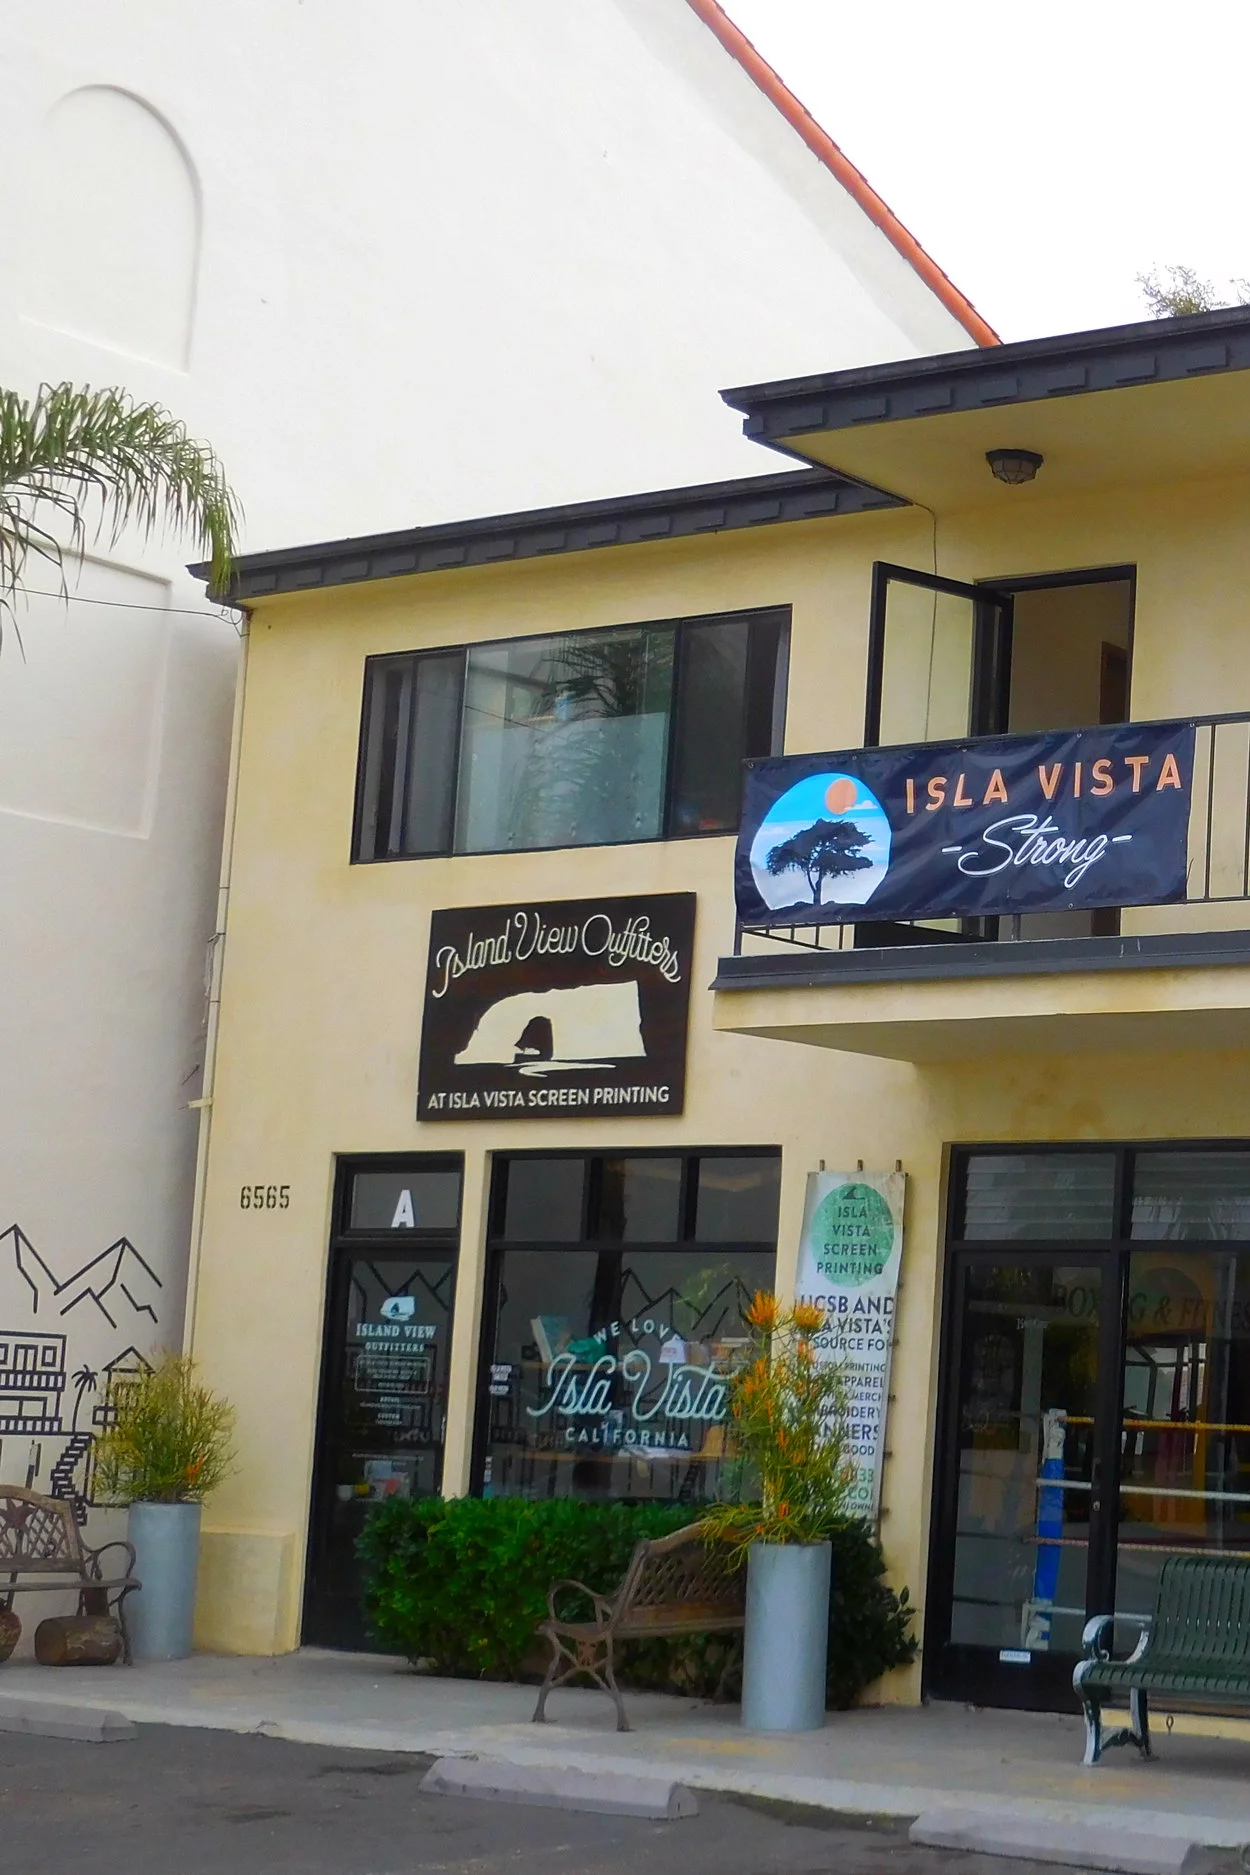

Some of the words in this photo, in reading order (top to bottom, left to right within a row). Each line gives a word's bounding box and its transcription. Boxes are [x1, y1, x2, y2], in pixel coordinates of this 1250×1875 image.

[905, 772, 1009, 814] ISLA
[1038, 753, 1182, 801] VISTA
[432, 919, 512, 998] Island
[514, 911, 578, 960] View
[582, 914, 682, 983] Outfitters
[427, 1091, 447, 1109] AT
[449, 1091, 480, 1109] ISLA
[483, 1090, 525, 1108] VISTA
[528, 1088, 589, 1107] SCREEN
[593, 1086, 670, 1105] PRINTING
[240, 1185, 290, 1209] 6565
[391, 1189, 415, 1228] A
[838, 1206, 868, 1219] ISLA
[832, 1224, 872, 1237] VISTA
[823, 1243, 878, 1256] SCREEN
[816, 1261, 884, 1275] PRINTING
[355, 1323, 400, 1337] ISLAND
[404, 1325, 437, 1339] VIEW
[593, 1320, 621, 1343] WE
[365, 1341, 424, 1352] OUTFITTERS
[813, 1337, 863, 1351] SOURCE
[867, 1339, 888, 1351] FO
[526, 1352, 616, 1416] Isla
[622, 1349, 741, 1421] Vista
[565, 1427, 689, 1447] CALIFORNIA
